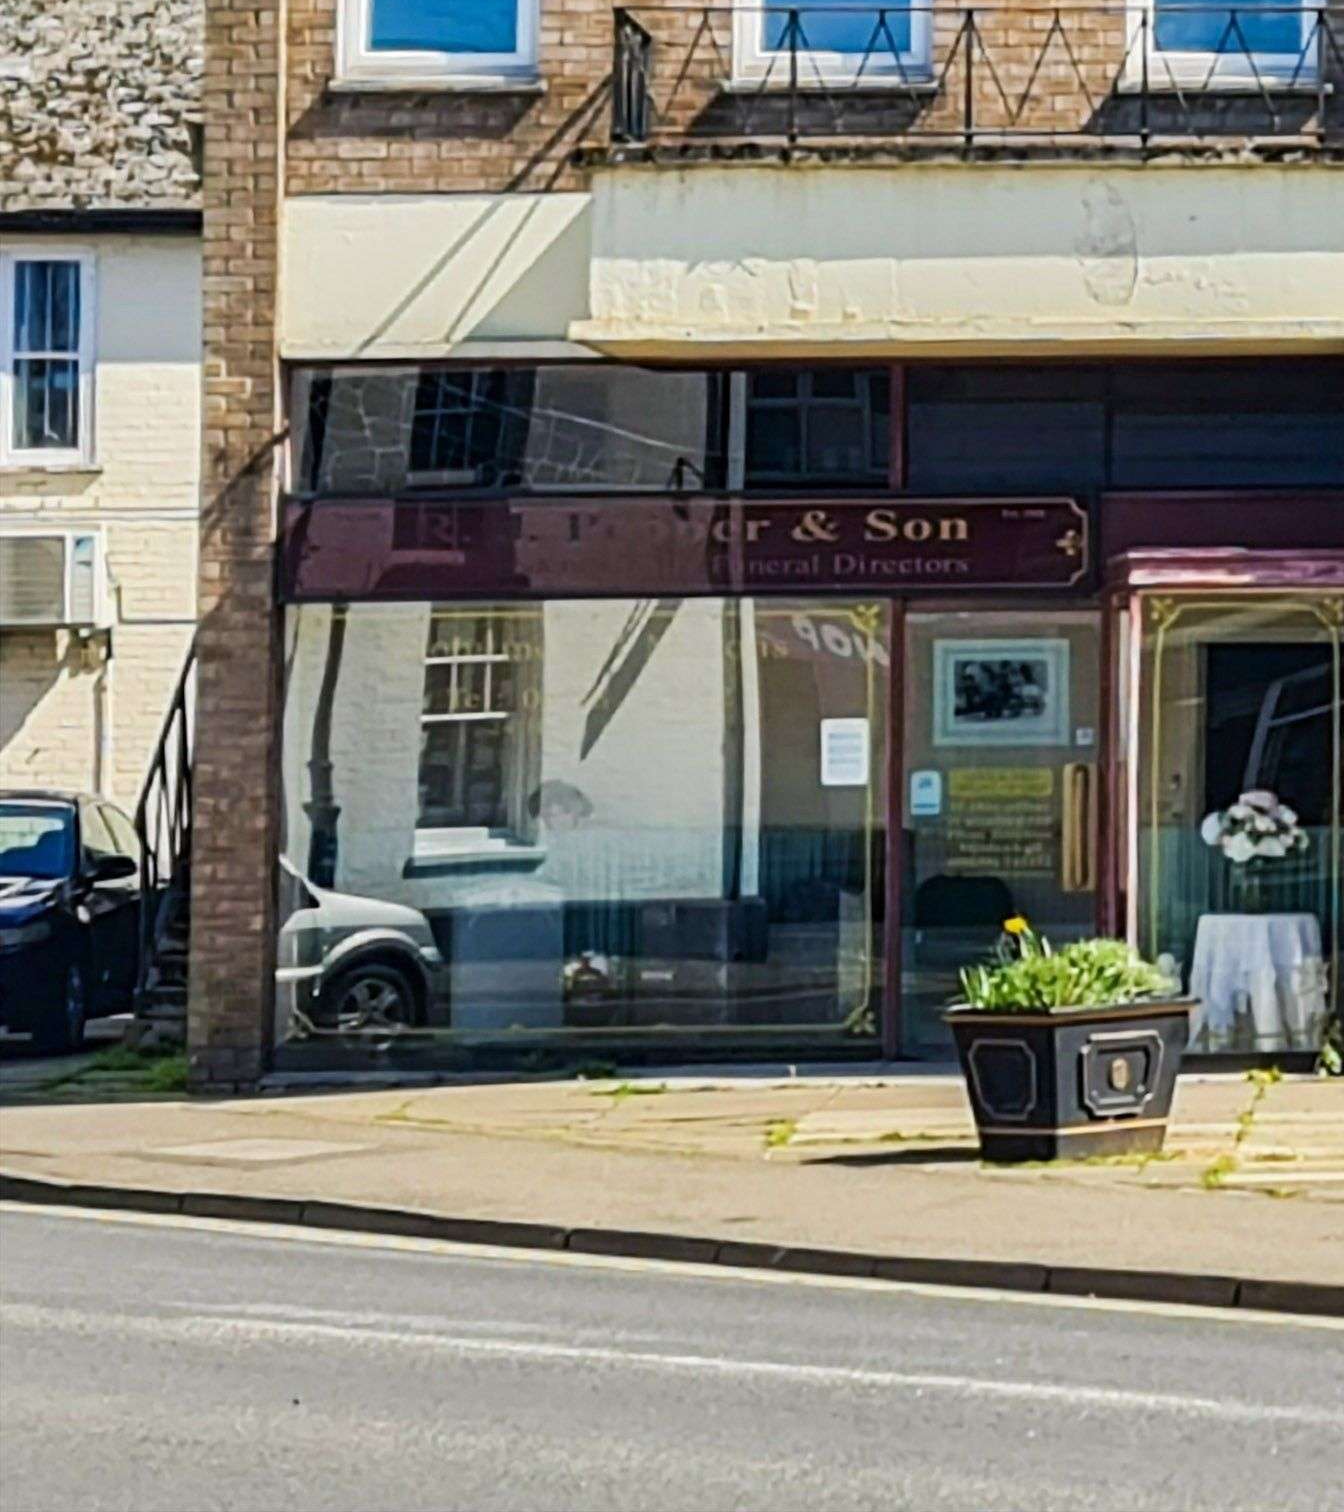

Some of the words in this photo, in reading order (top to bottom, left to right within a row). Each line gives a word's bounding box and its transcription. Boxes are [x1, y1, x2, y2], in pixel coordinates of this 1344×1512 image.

[792, 509, 840, 542] &
[863, 508, 968, 542] Son
[833, 554, 970, 575] Directors
